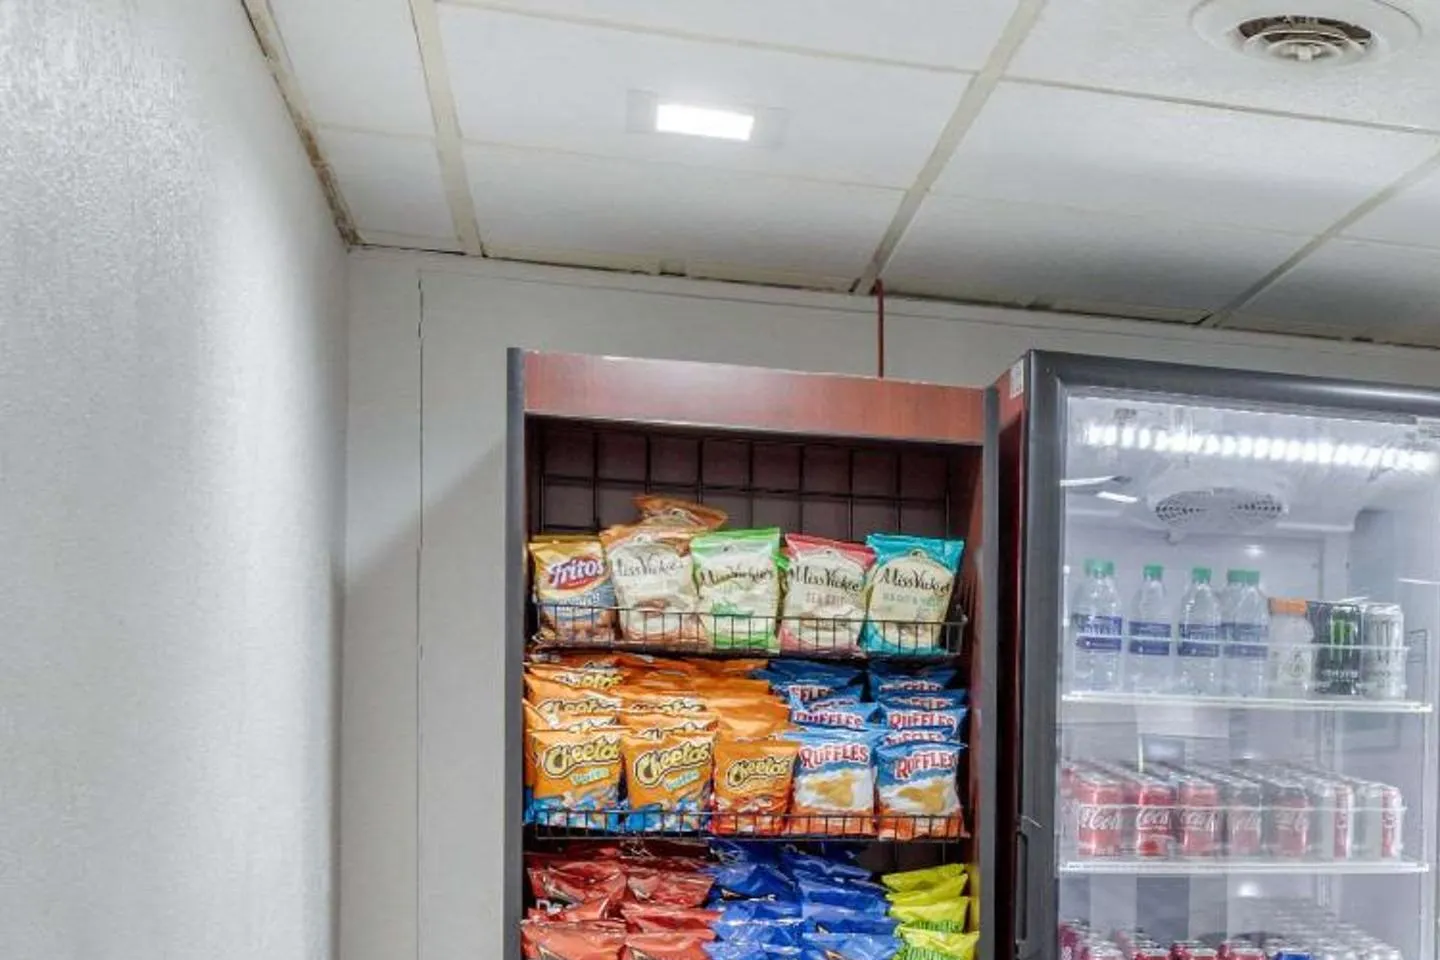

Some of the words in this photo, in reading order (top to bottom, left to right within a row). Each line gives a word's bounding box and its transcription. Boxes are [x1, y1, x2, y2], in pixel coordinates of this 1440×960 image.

[549, 556, 605, 584] Fritos
[543, 738, 621, 777] Cheetos
[634, 741, 713, 787] Cheetos
[800, 743, 870, 769] RUFFLES
[894, 750, 958, 779] RUFFLES
[727, 757, 789, 789] Cheetos
